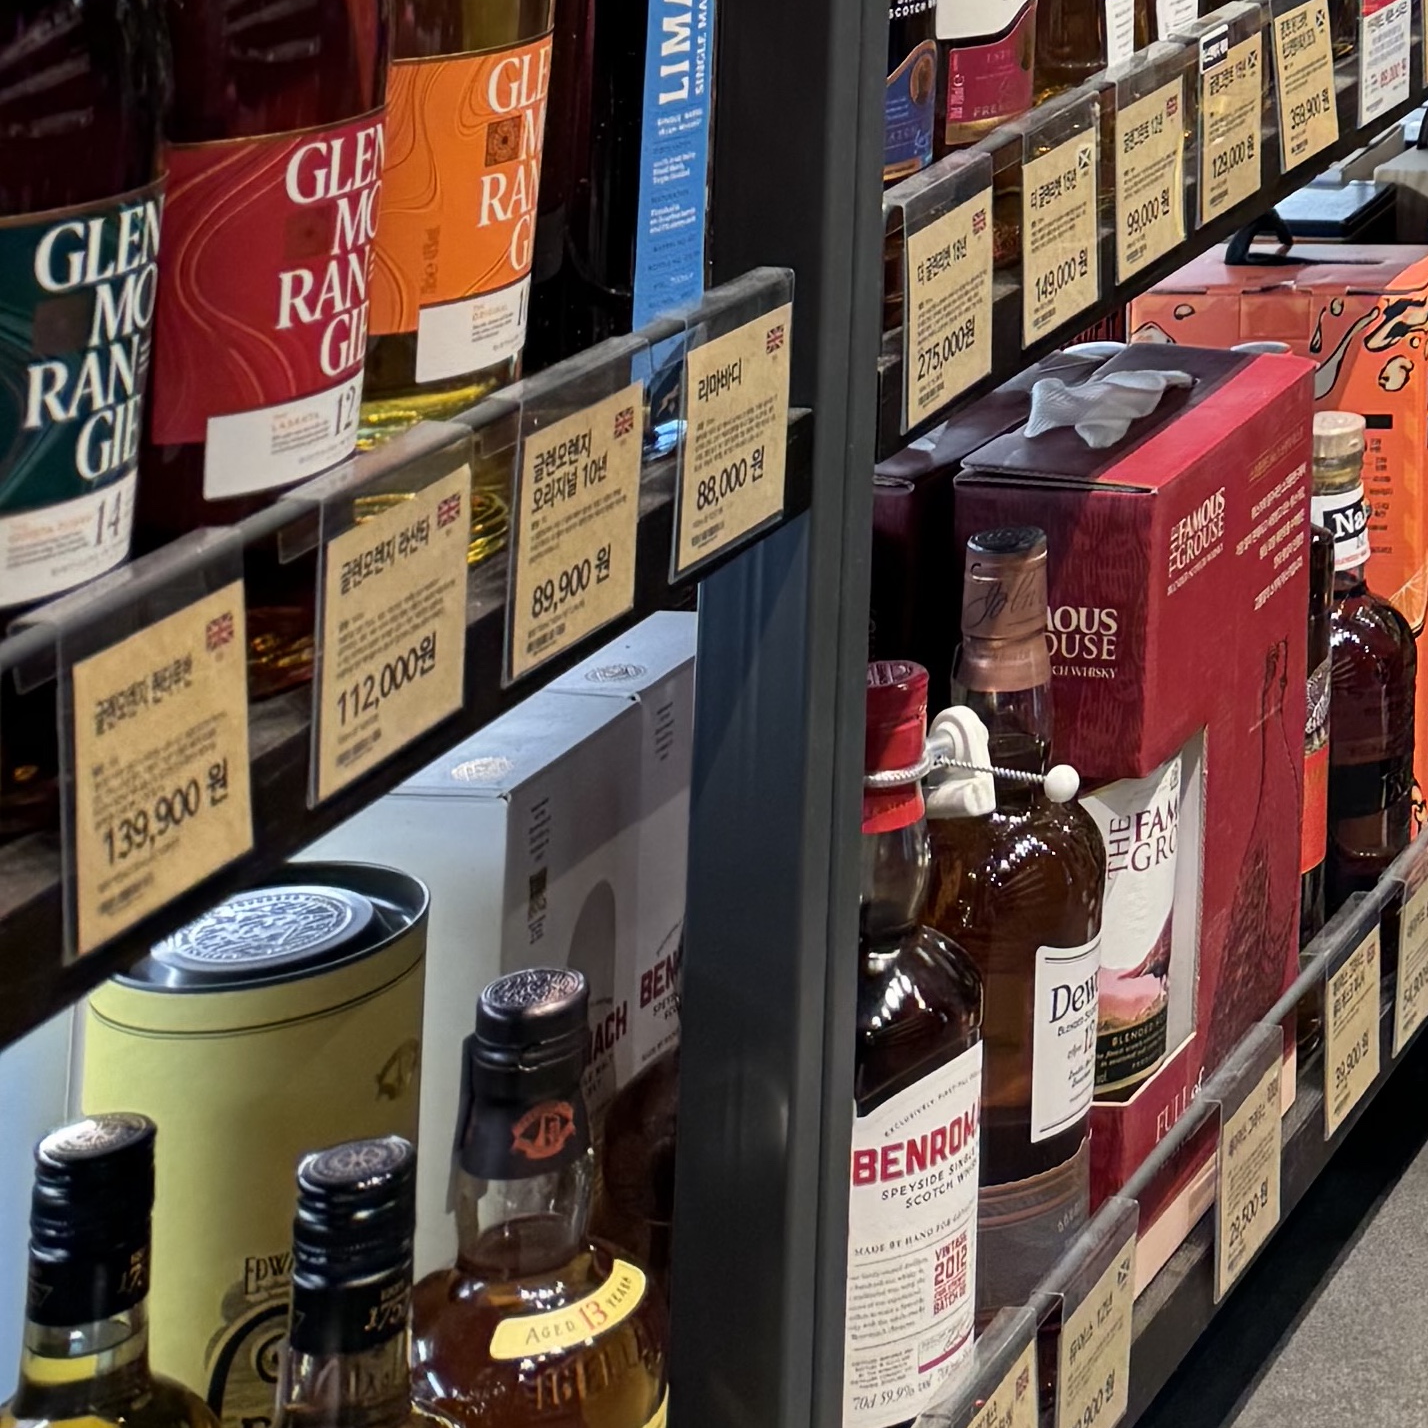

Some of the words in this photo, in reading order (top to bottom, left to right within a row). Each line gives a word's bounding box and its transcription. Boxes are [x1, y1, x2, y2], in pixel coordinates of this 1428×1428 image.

[696, 456, 748, 511] 88,000
[749, 444, 765, 481] 원
[531, 560, 592, 619] 89,900
[594, 542, 612, 585] 원
[336, 631, 438, 727] 112,000원
[103, 779, 201, 867] 139,900
[206, 757, 229, 809] 원
[1107, 815, 1131, 880] THE
[881, 1168, 944, 1201] SPEYSIDE
[905, 1179, 955, 1209] SCOTCH
[933, 1245, 968, 1287] 2012
[522, 1315, 577, 1346] AGED
[580, 1292, 610, 1335] 13
